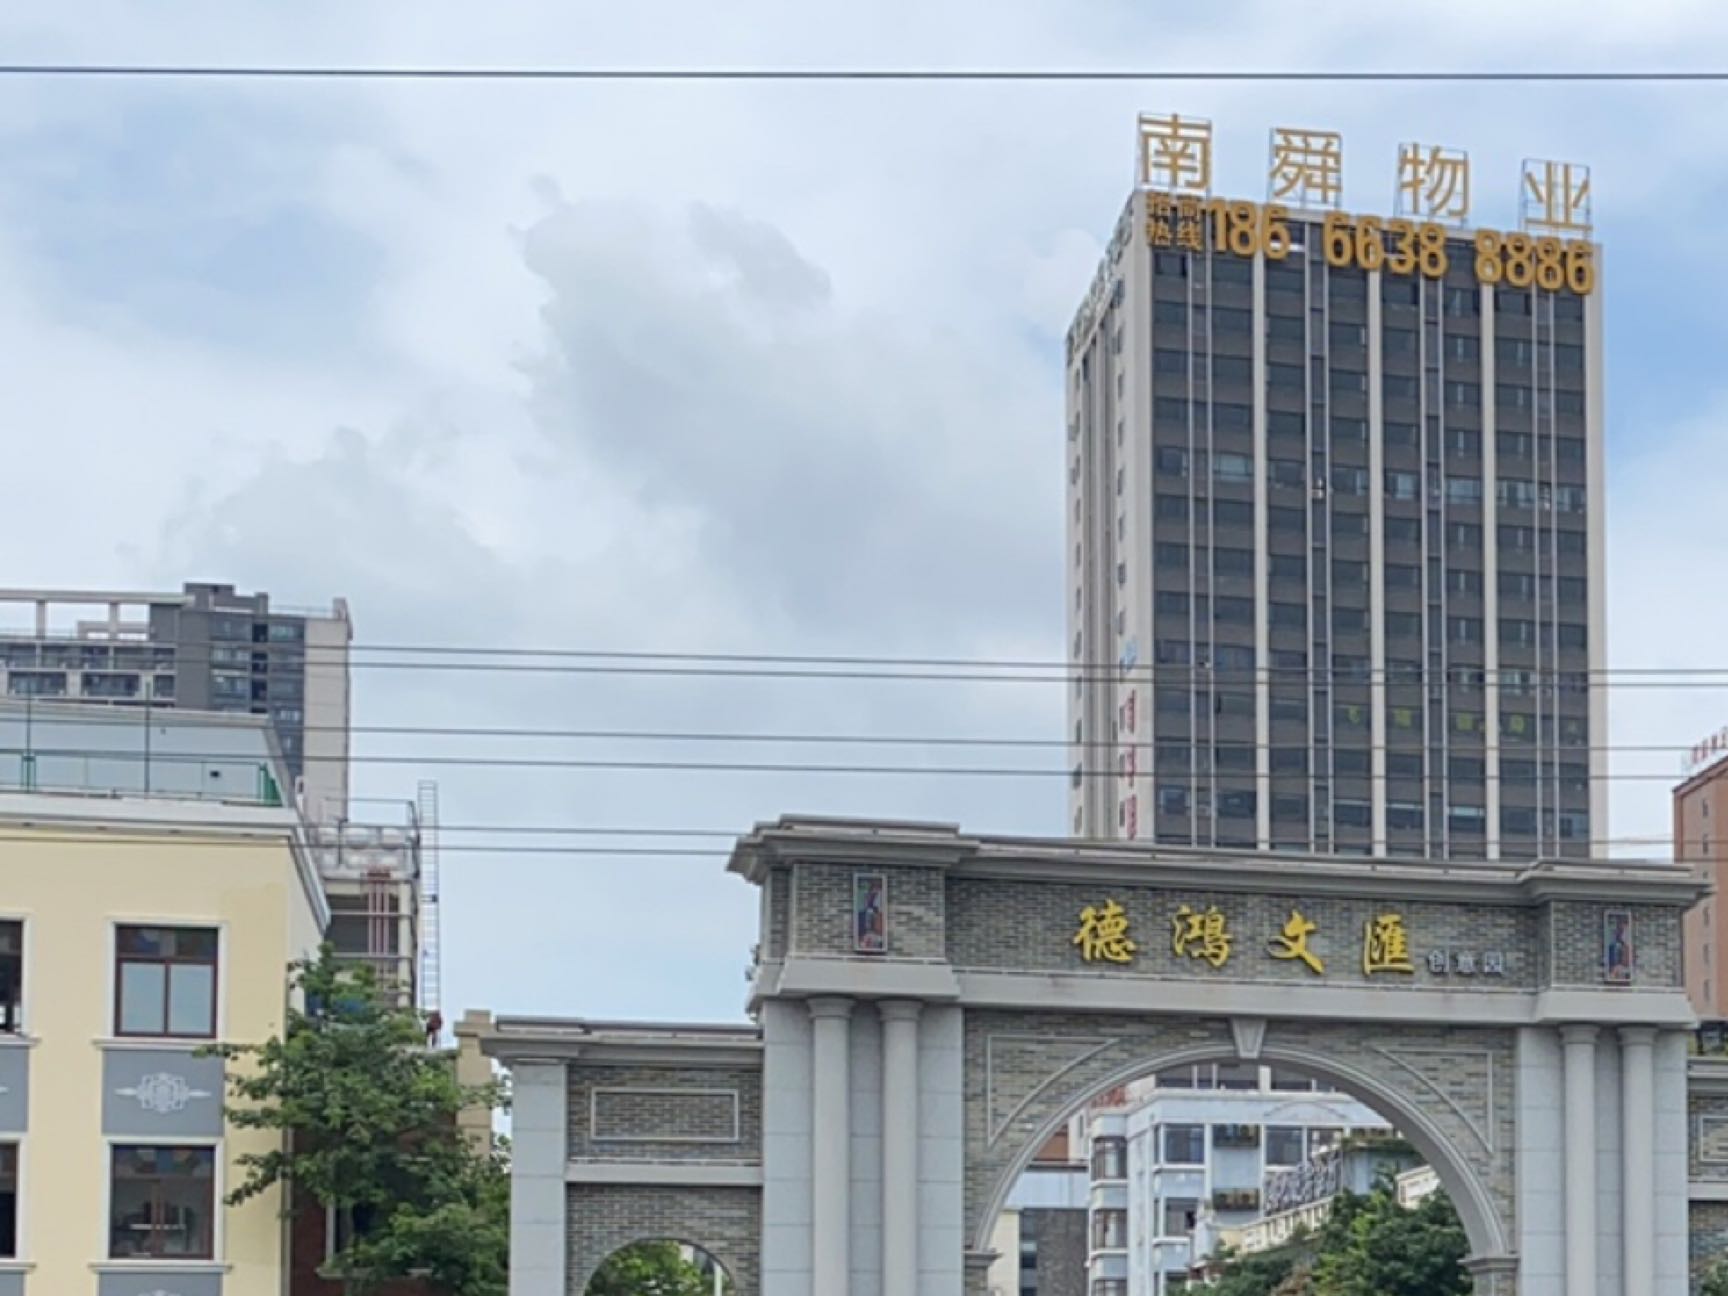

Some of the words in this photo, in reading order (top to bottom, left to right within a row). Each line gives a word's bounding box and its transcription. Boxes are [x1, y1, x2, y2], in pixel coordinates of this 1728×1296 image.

[1139, 112, 1592, 232] 南舜物业
[1207, 197, 1291, 262] 186
[1322, 210, 1449, 280] 6638
[1474, 228, 1595, 295] 8886
[1427, 948, 1504, 974] 创意园
